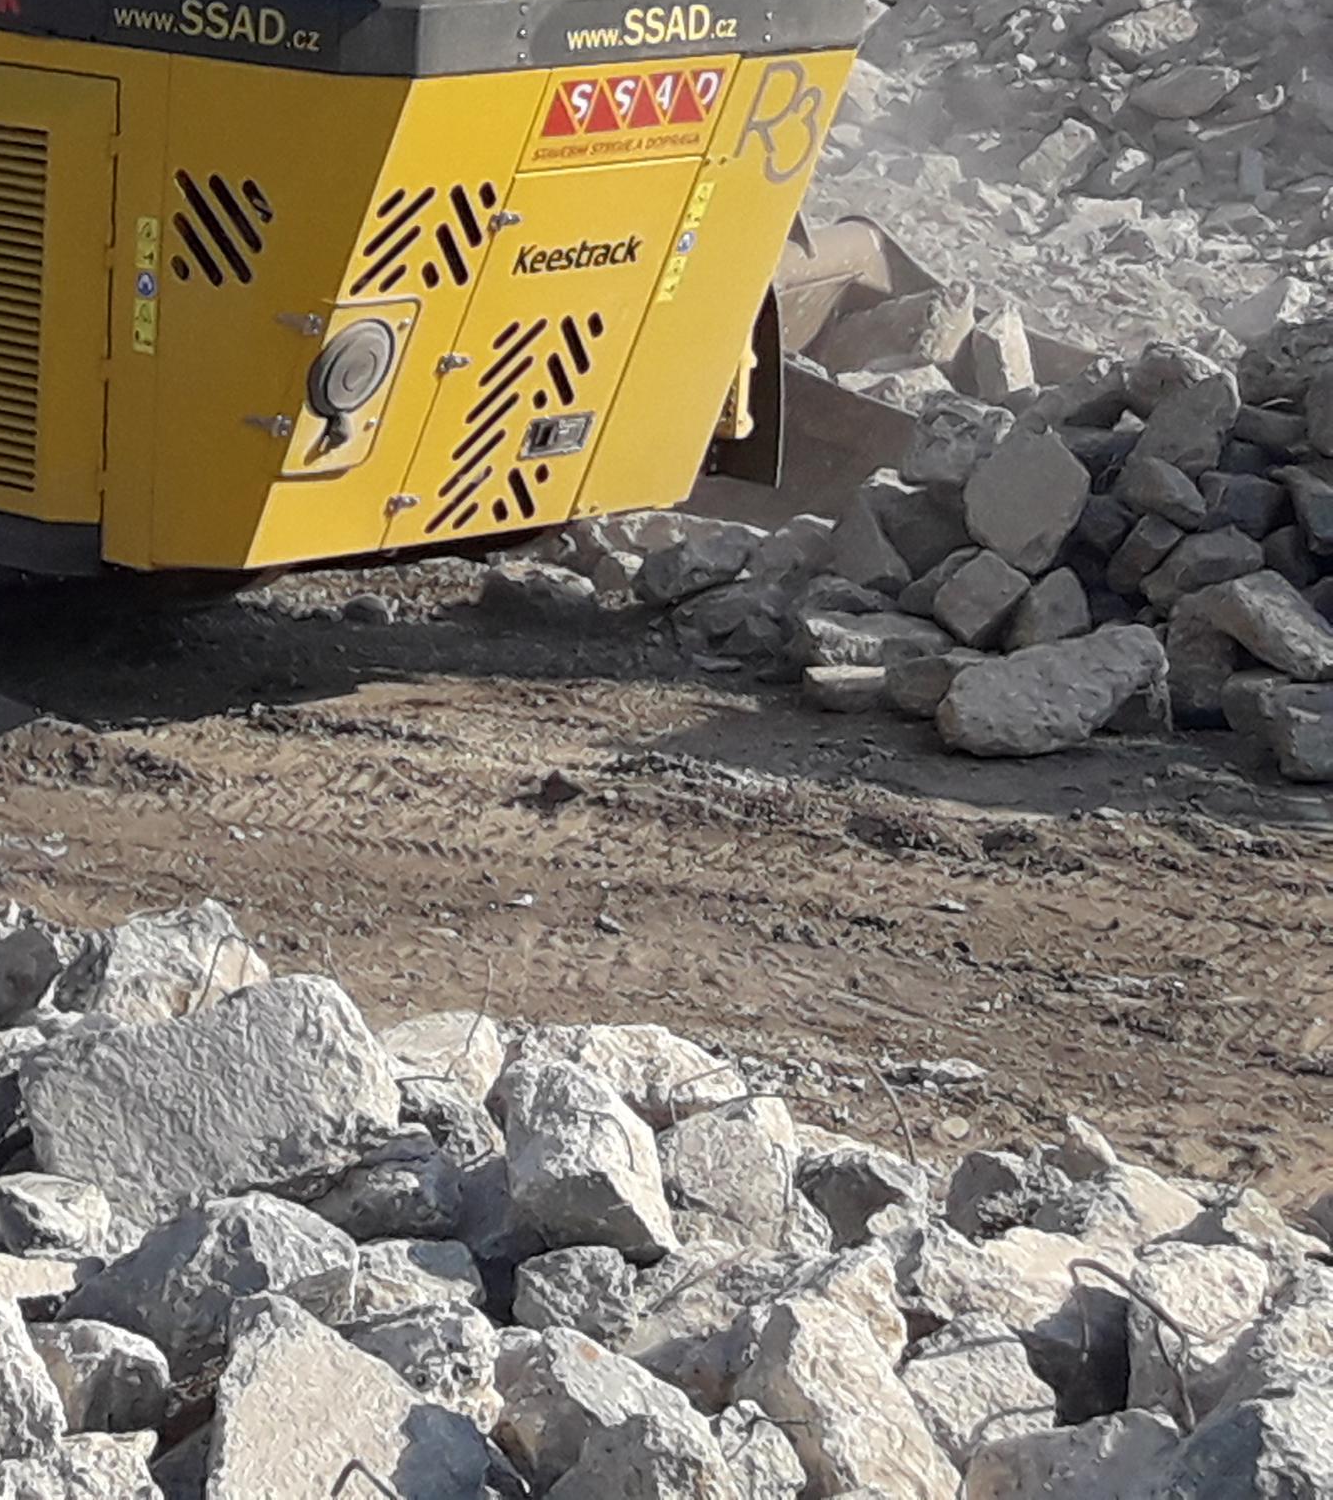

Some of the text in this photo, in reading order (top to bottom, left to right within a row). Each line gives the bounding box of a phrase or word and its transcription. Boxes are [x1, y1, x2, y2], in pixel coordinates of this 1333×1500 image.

[566, 4, 738, 50] www.SSAD.cz
[570, 71, 720, 120] SSAD
[733, 60, 822, 185] R3
[511, 235, 644, 275] Keestrack
